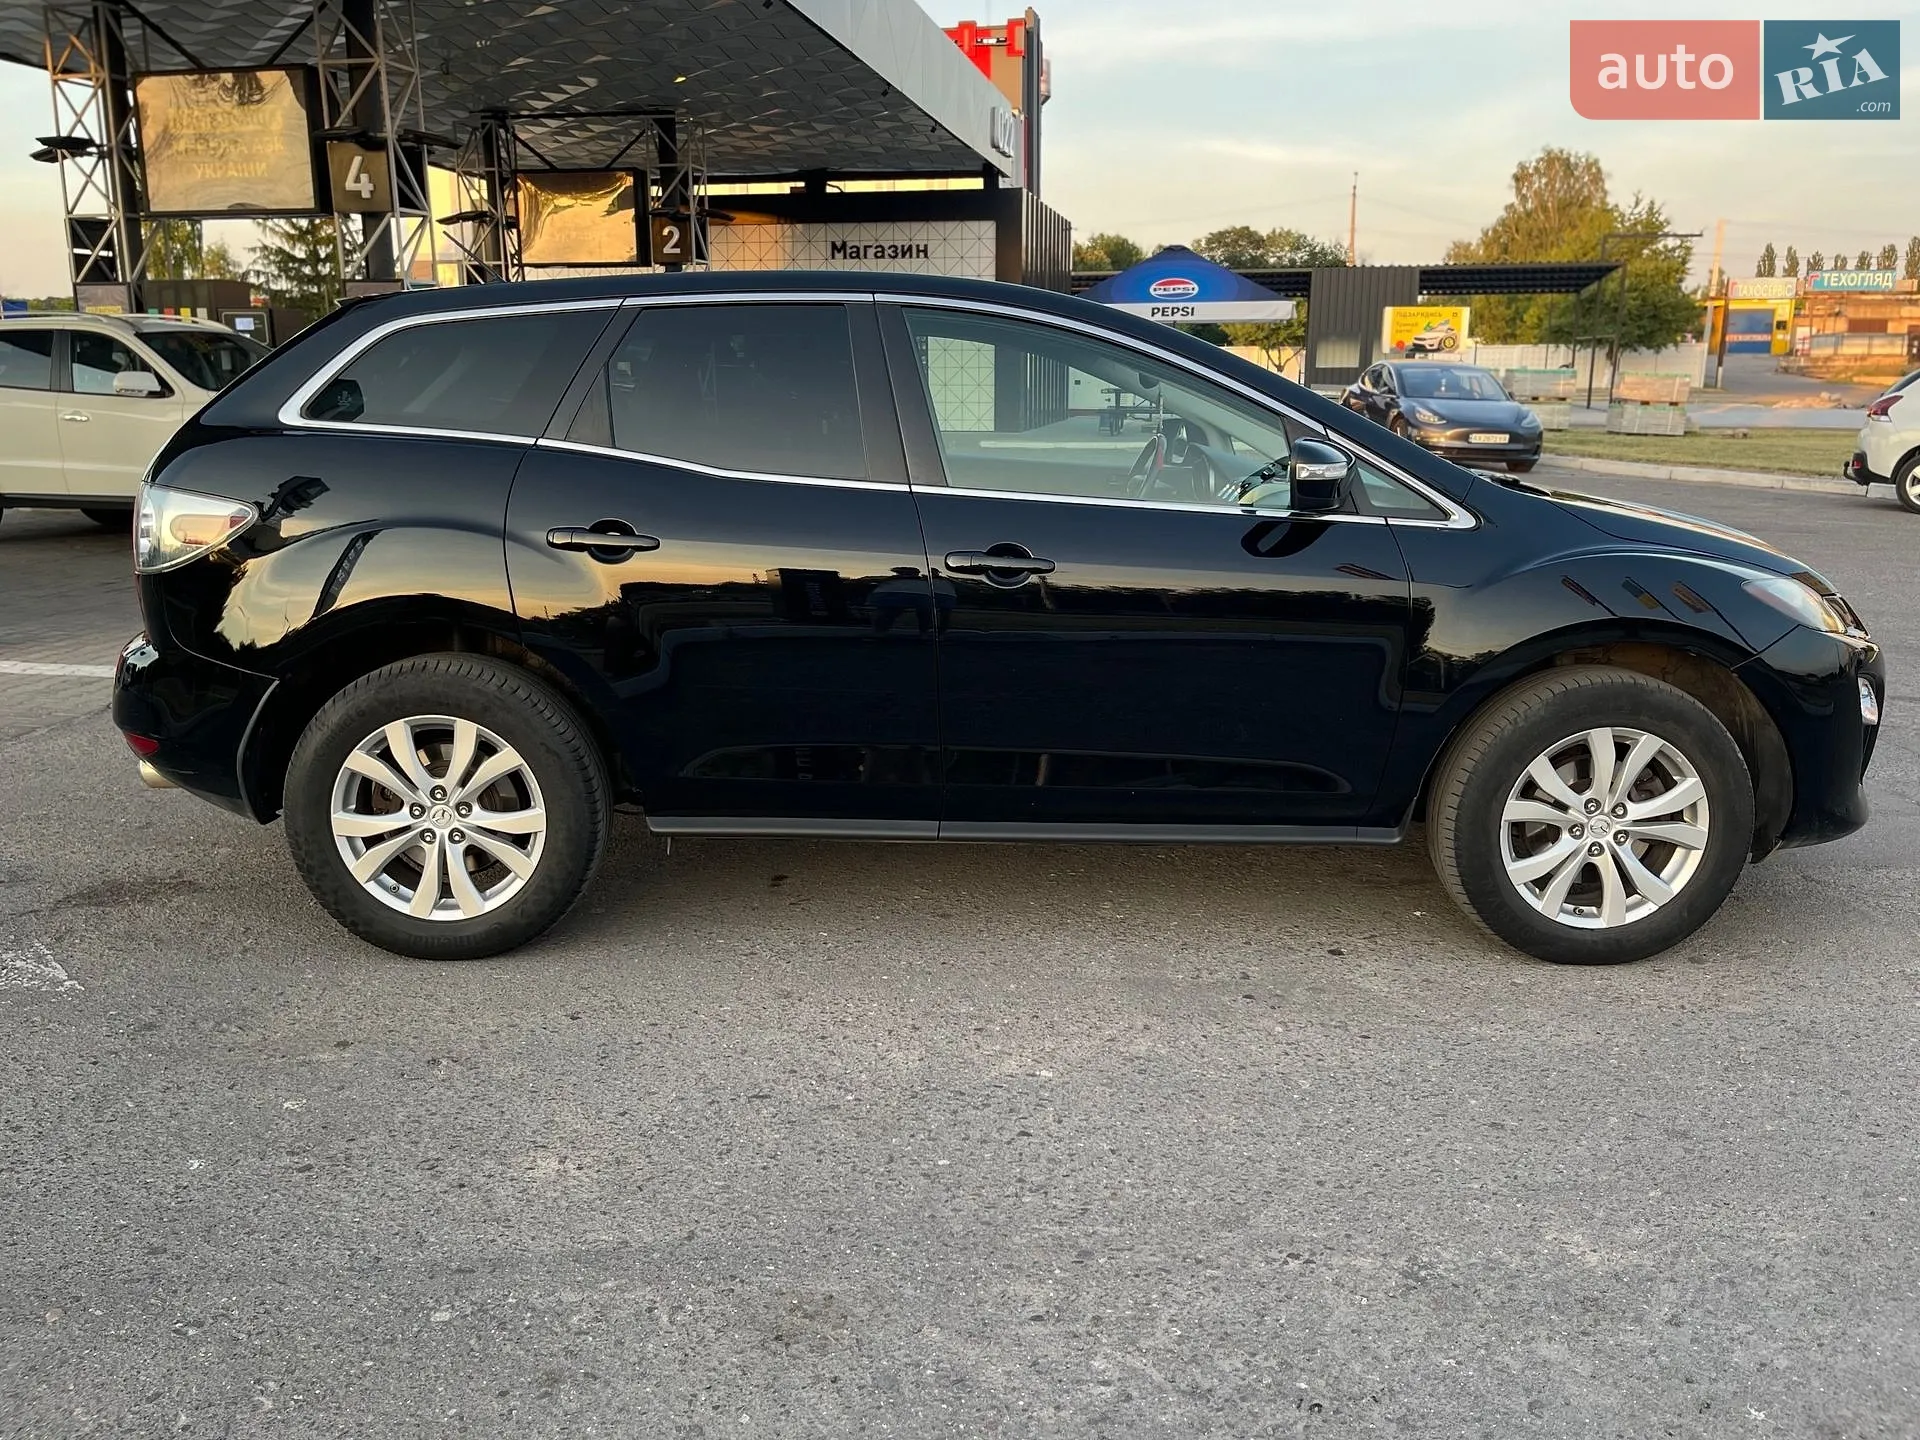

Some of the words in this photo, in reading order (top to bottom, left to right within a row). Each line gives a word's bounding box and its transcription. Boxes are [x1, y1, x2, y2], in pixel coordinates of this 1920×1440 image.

[345, 155, 374, 199] 4
[662, 225, 681, 254] 2
[831, 240, 929, 260] Магазин
[1823, 271, 1893, 288] ТЕХОГЛЯД
[1151, 306, 1195, 317] PEPSI
